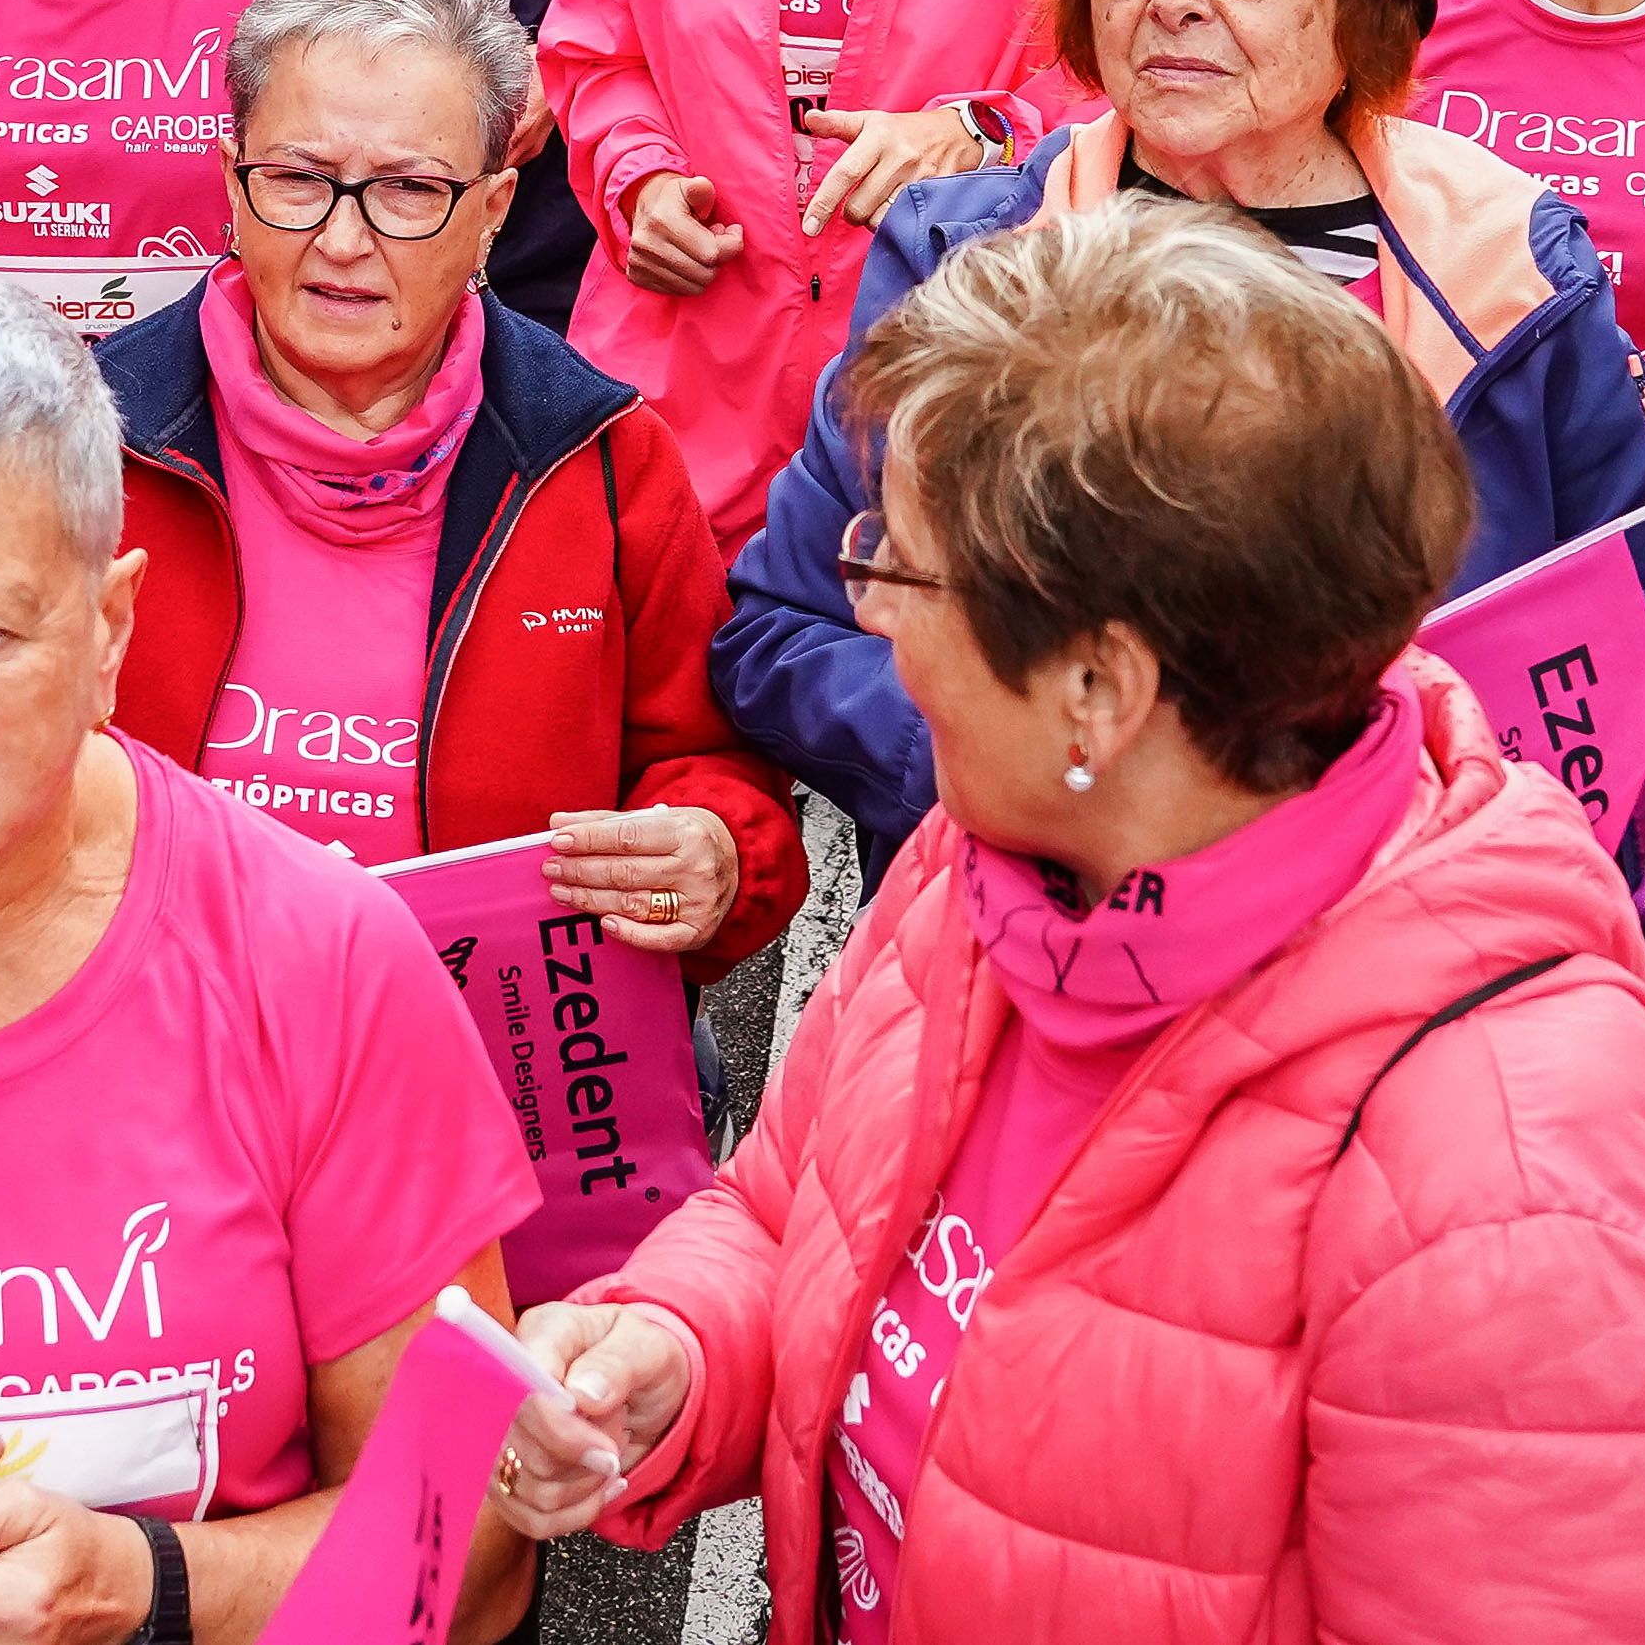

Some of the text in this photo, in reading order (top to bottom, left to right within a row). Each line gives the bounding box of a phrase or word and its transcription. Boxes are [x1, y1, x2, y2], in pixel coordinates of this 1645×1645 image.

[110, 112, 236, 142] CAROBE
[125, 141, 209, 156] hair beauty
[34, 223, 48, 237] LA
[51, 223, 86, 238] SERNA
[557, 624, 593, 634] SPORT
[498, 965, 547, 1163] Smile Designers
[538, 912, 637, 1196] Ezedent
